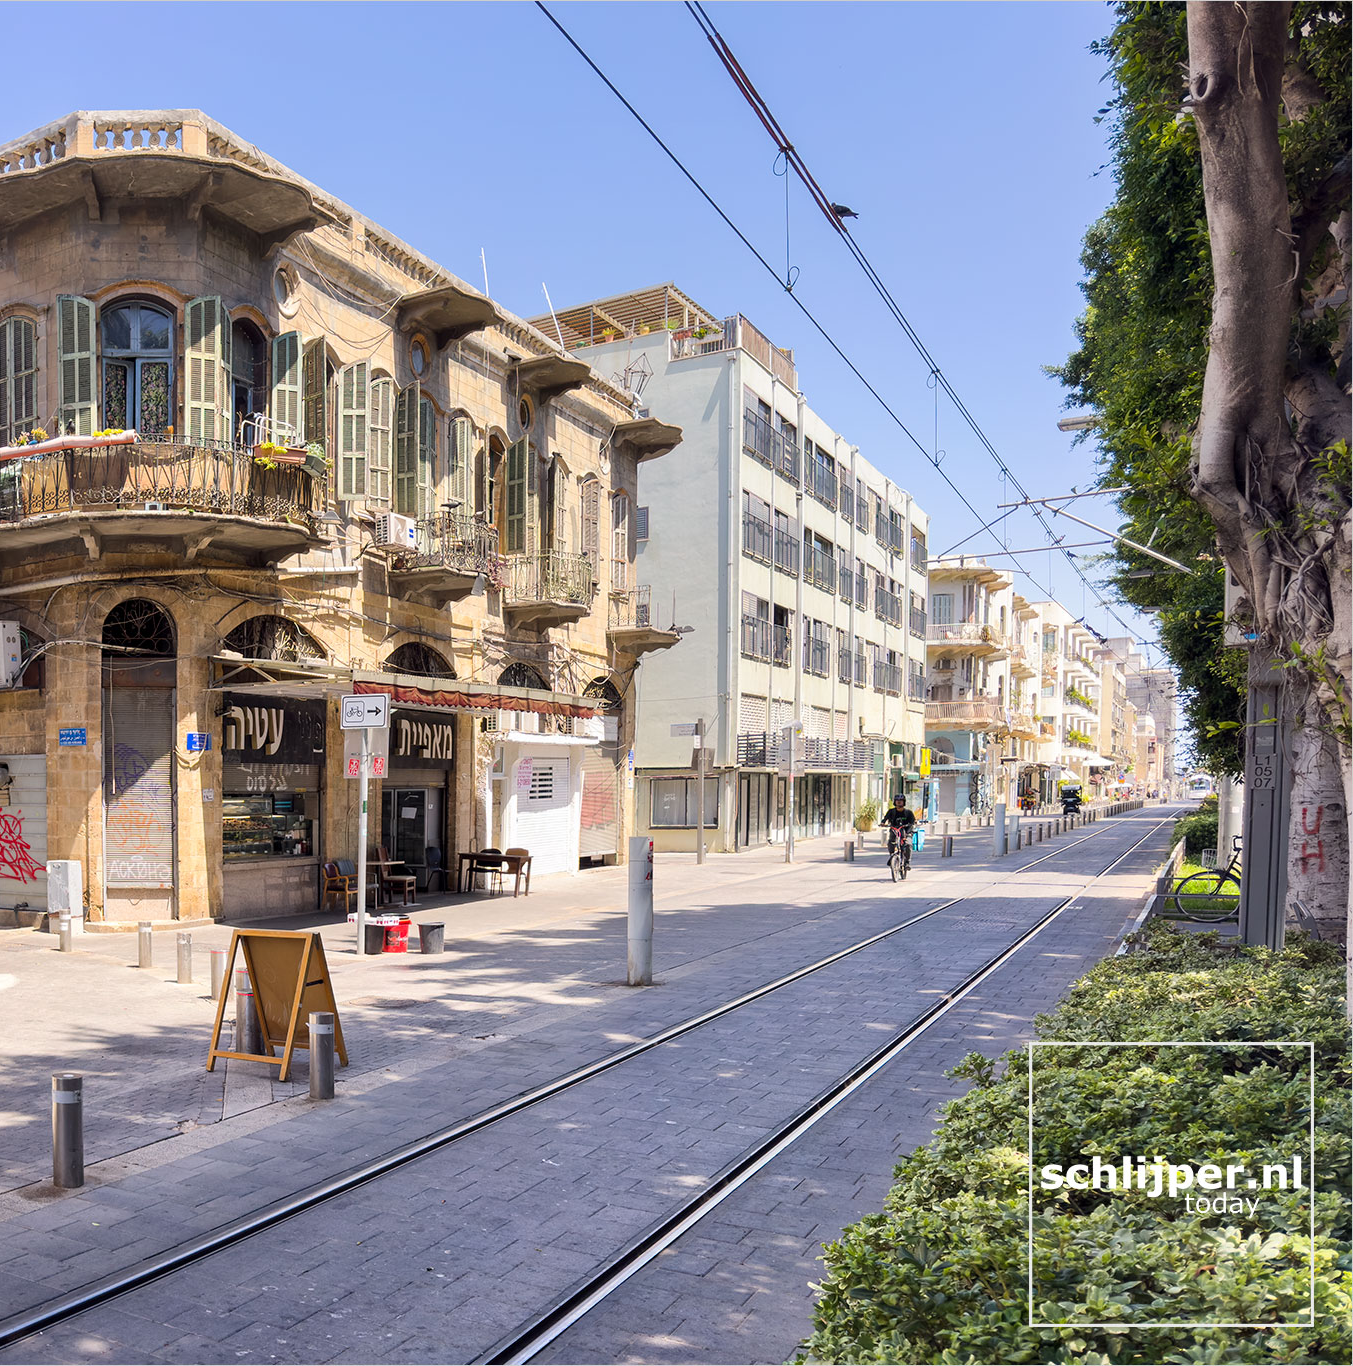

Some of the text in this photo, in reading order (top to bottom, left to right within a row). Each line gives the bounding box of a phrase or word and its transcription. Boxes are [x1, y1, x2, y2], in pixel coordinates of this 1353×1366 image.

[226, 705, 284, 755] עטיה
[398, 719, 453, 759] מאפיית
[1255, 756, 1271, 766] L1
[1254, 766, 1273, 777] 05
[1254, 778, 1272, 788] 07
